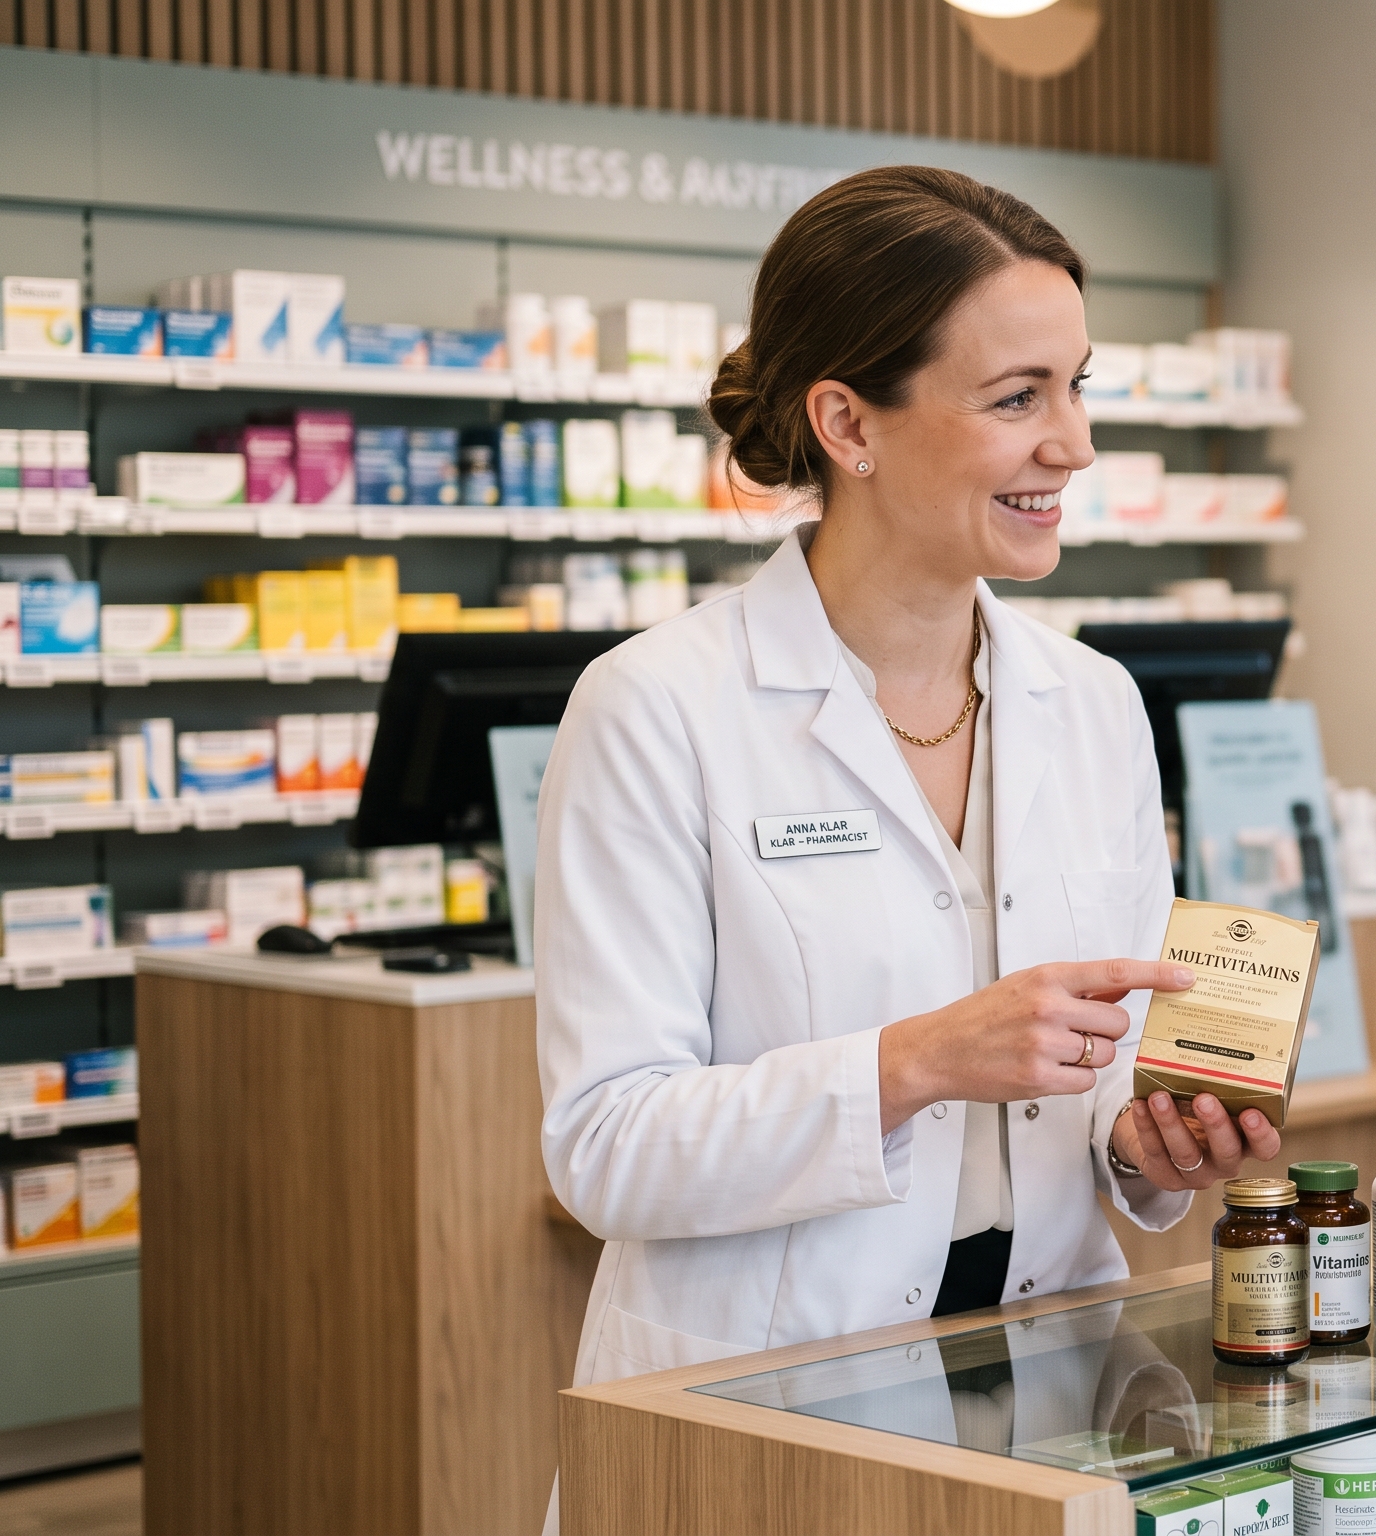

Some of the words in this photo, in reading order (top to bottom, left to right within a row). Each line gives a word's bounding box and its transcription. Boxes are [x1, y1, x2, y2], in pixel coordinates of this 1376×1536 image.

[375, 130, 632, 200] WELLNESS
[638, 151, 678, 203] &
[770, 837, 796, 848] KLAR
[806, 832, 868, 845] PHARMACIST
[786, 823, 817, 835] ANNA
[819, 820, 848, 832] KLAR
[1167, 947, 1300, 983] MULTIVITAMINS
